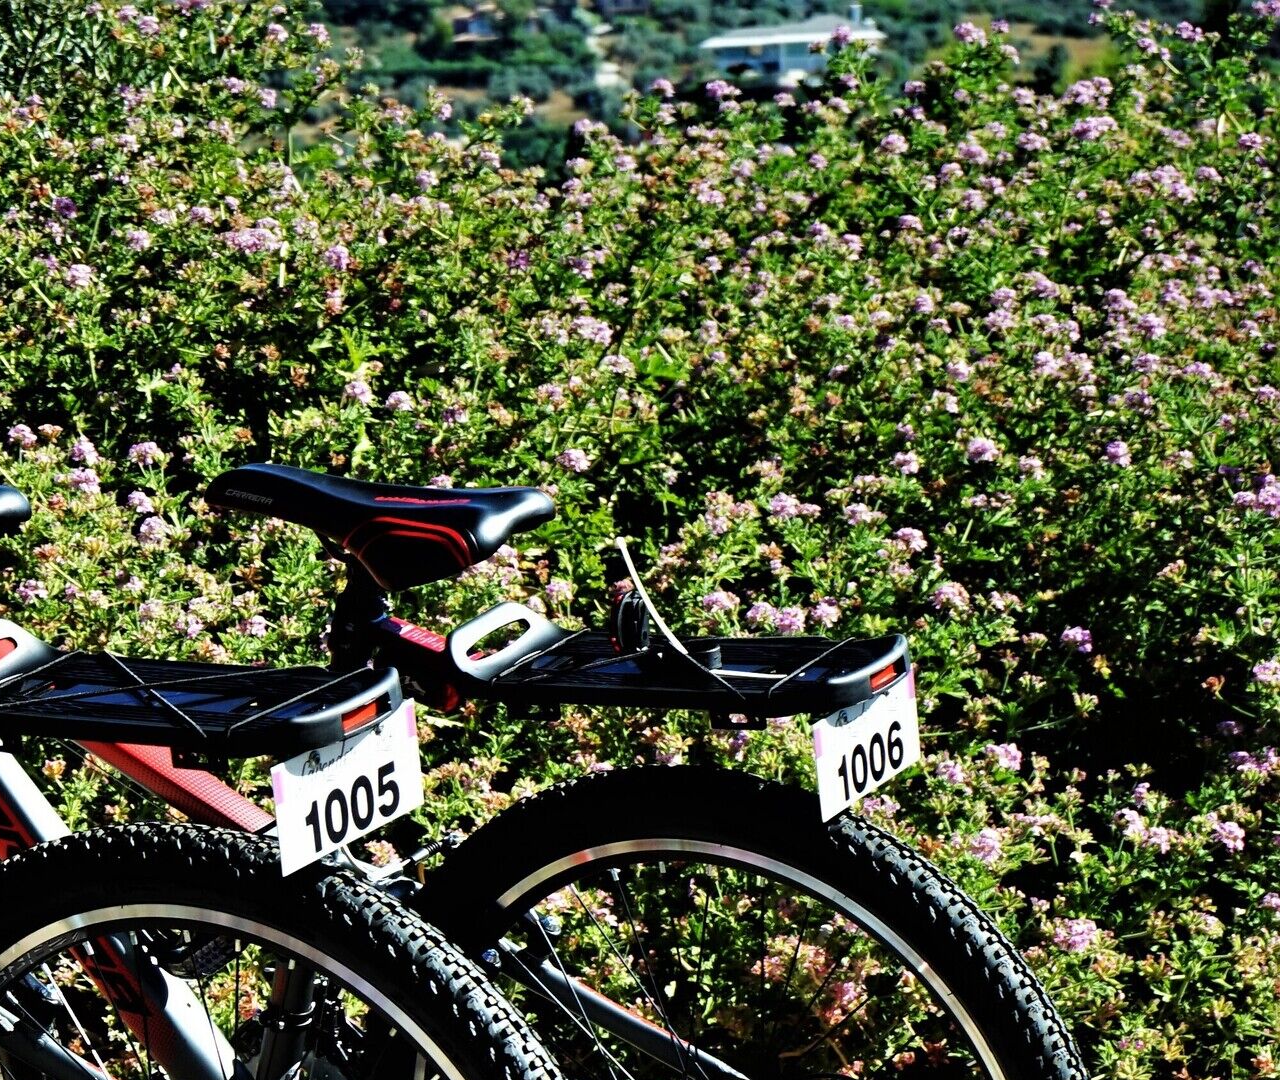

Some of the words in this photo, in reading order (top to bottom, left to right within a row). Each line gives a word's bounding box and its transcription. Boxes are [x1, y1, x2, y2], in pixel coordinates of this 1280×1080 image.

[224, 488, 273, 505] CARRERA
[838, 720, 904, 801] 1006
[305, 760, 400, 853] 1005
